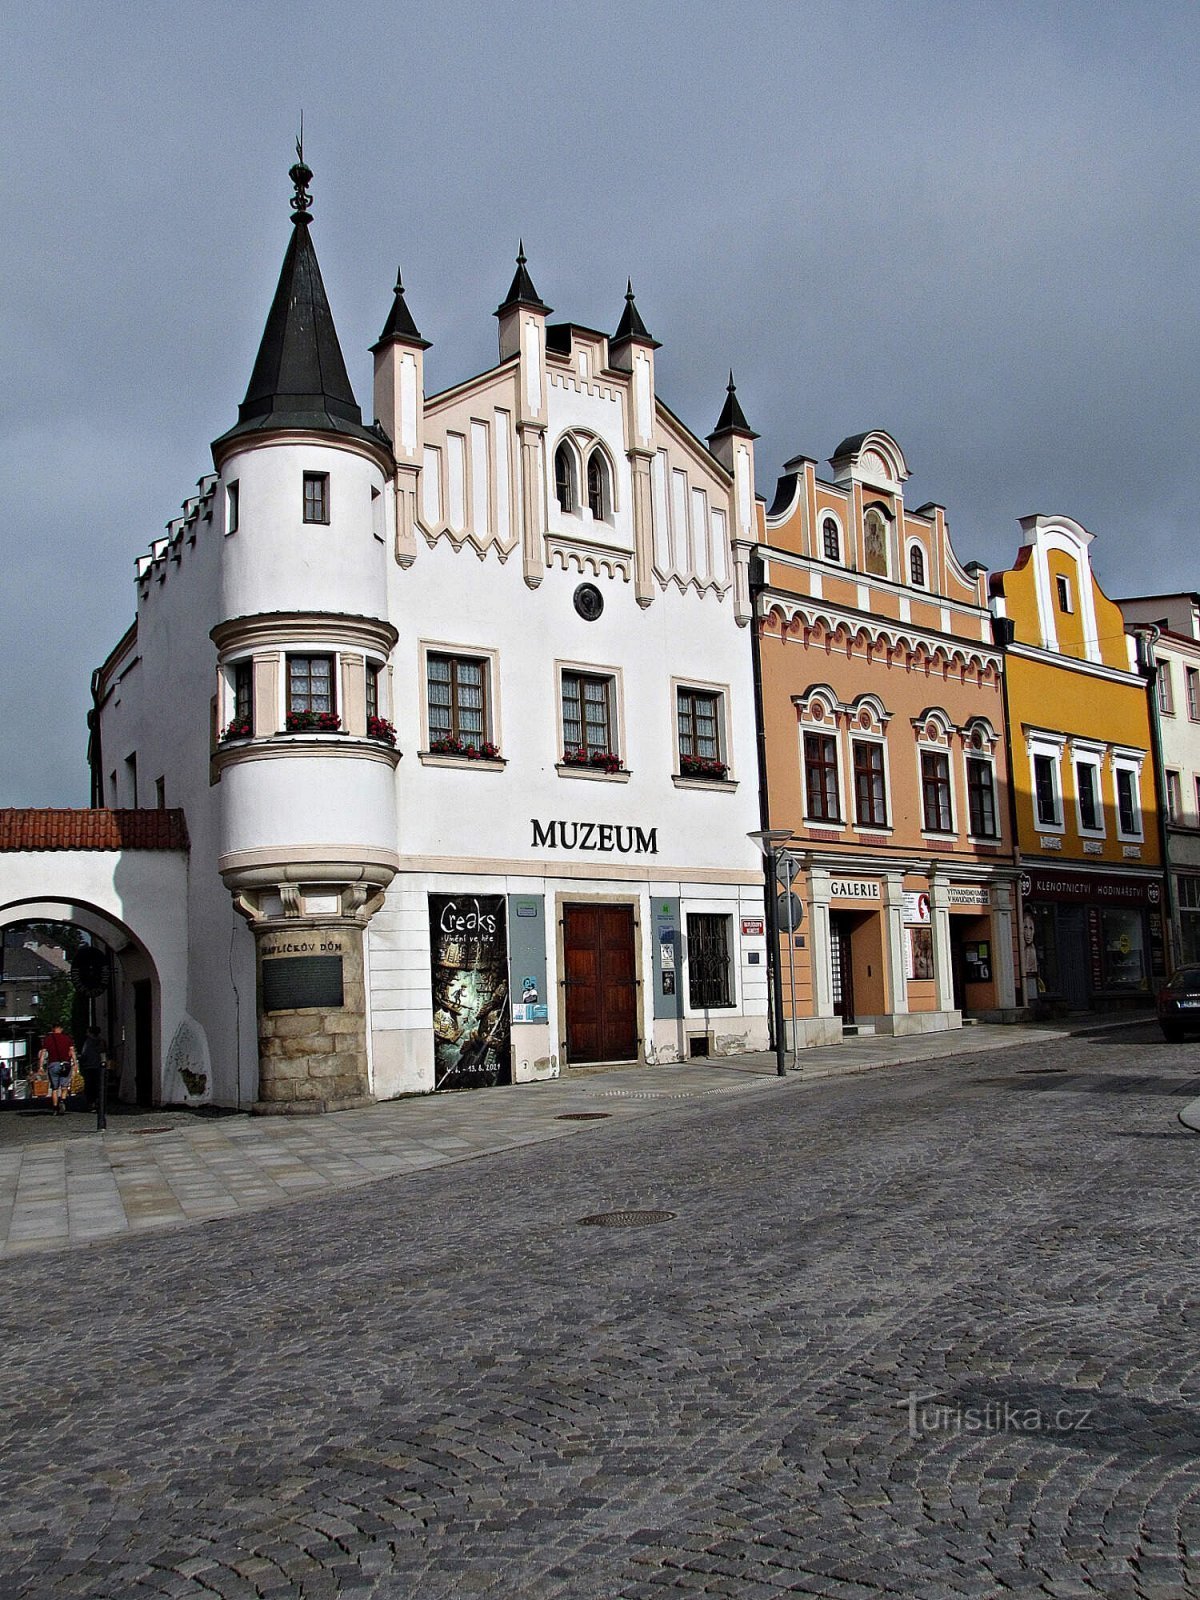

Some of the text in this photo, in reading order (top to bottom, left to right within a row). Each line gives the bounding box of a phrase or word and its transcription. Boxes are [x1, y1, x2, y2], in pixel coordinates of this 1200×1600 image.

[530, 818, 660, 854] MUZEUM
[831, 881, 878, 897] GALERIE
[1036, 880, 1143, 897] KLENOTNICTVÍ HODINÁŘSTVÍ
[440, 898, 497, 933] Creaks
[444, 933, 467, 942] Umění
[262, 941, 342, 954] HAVLÍČKŮV DŮM
